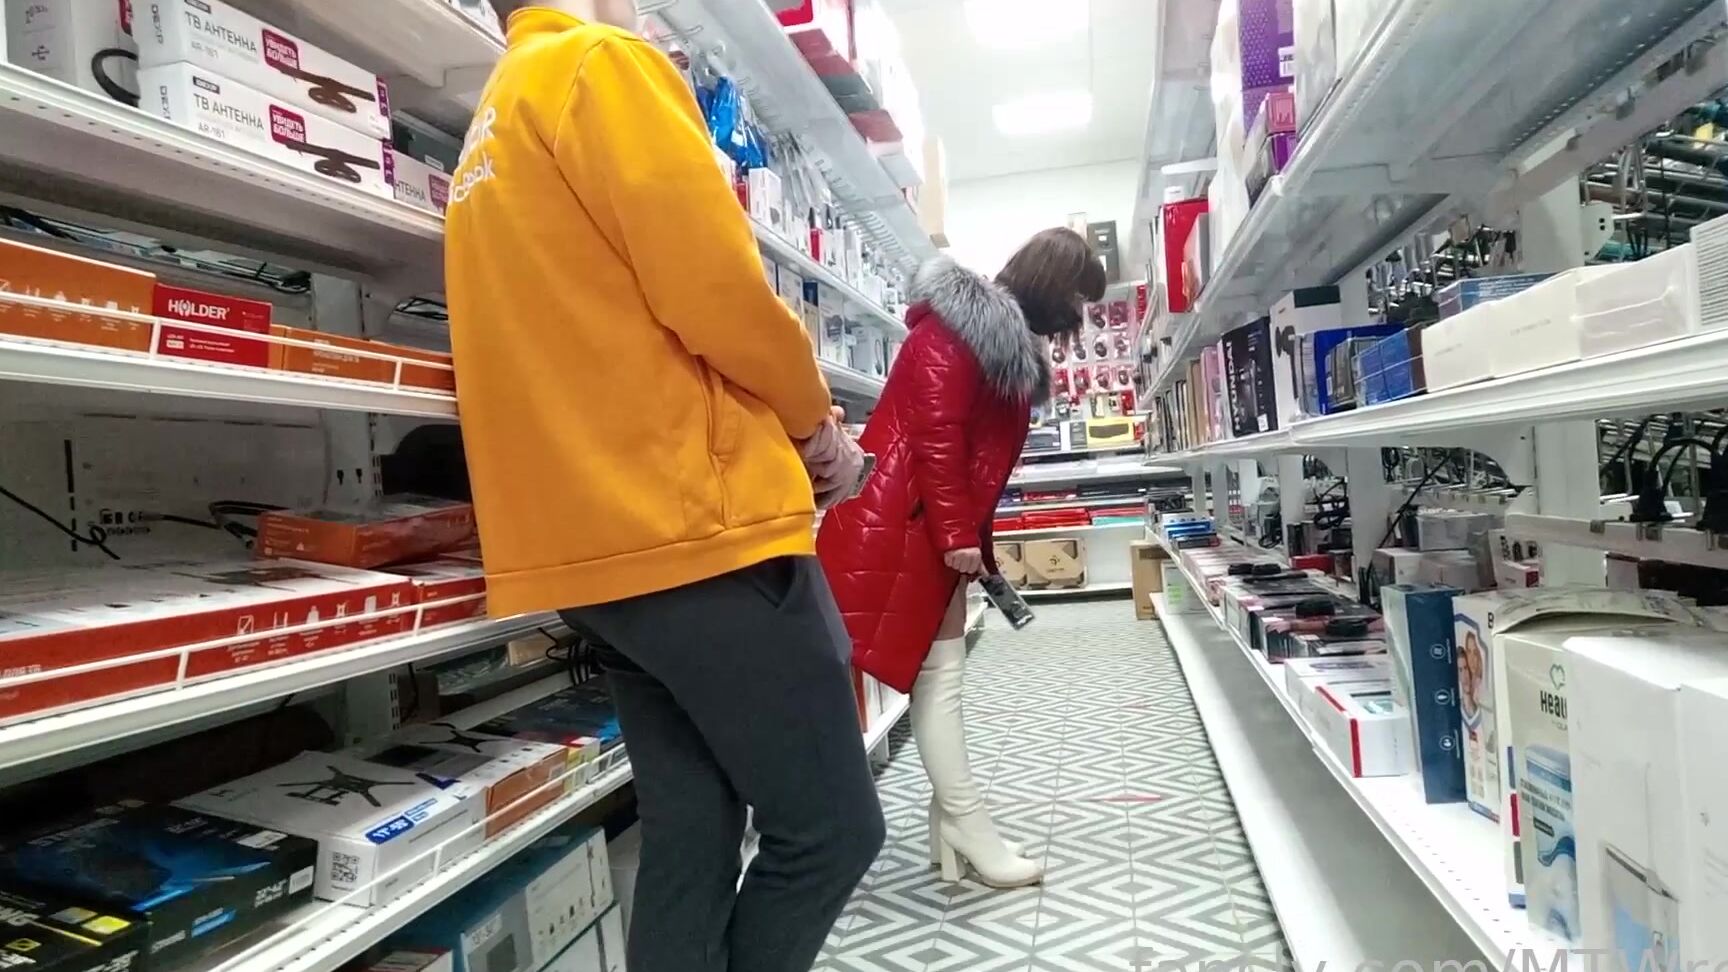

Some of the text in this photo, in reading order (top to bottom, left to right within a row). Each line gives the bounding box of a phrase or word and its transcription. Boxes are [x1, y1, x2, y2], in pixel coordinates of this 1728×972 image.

[185, 11, 257, 53] ТВ АНТЕННА
[193, 93, 265, 130] ТВ АНТЕННА
[1226, 341, 1240, 430] HYUNDAI
